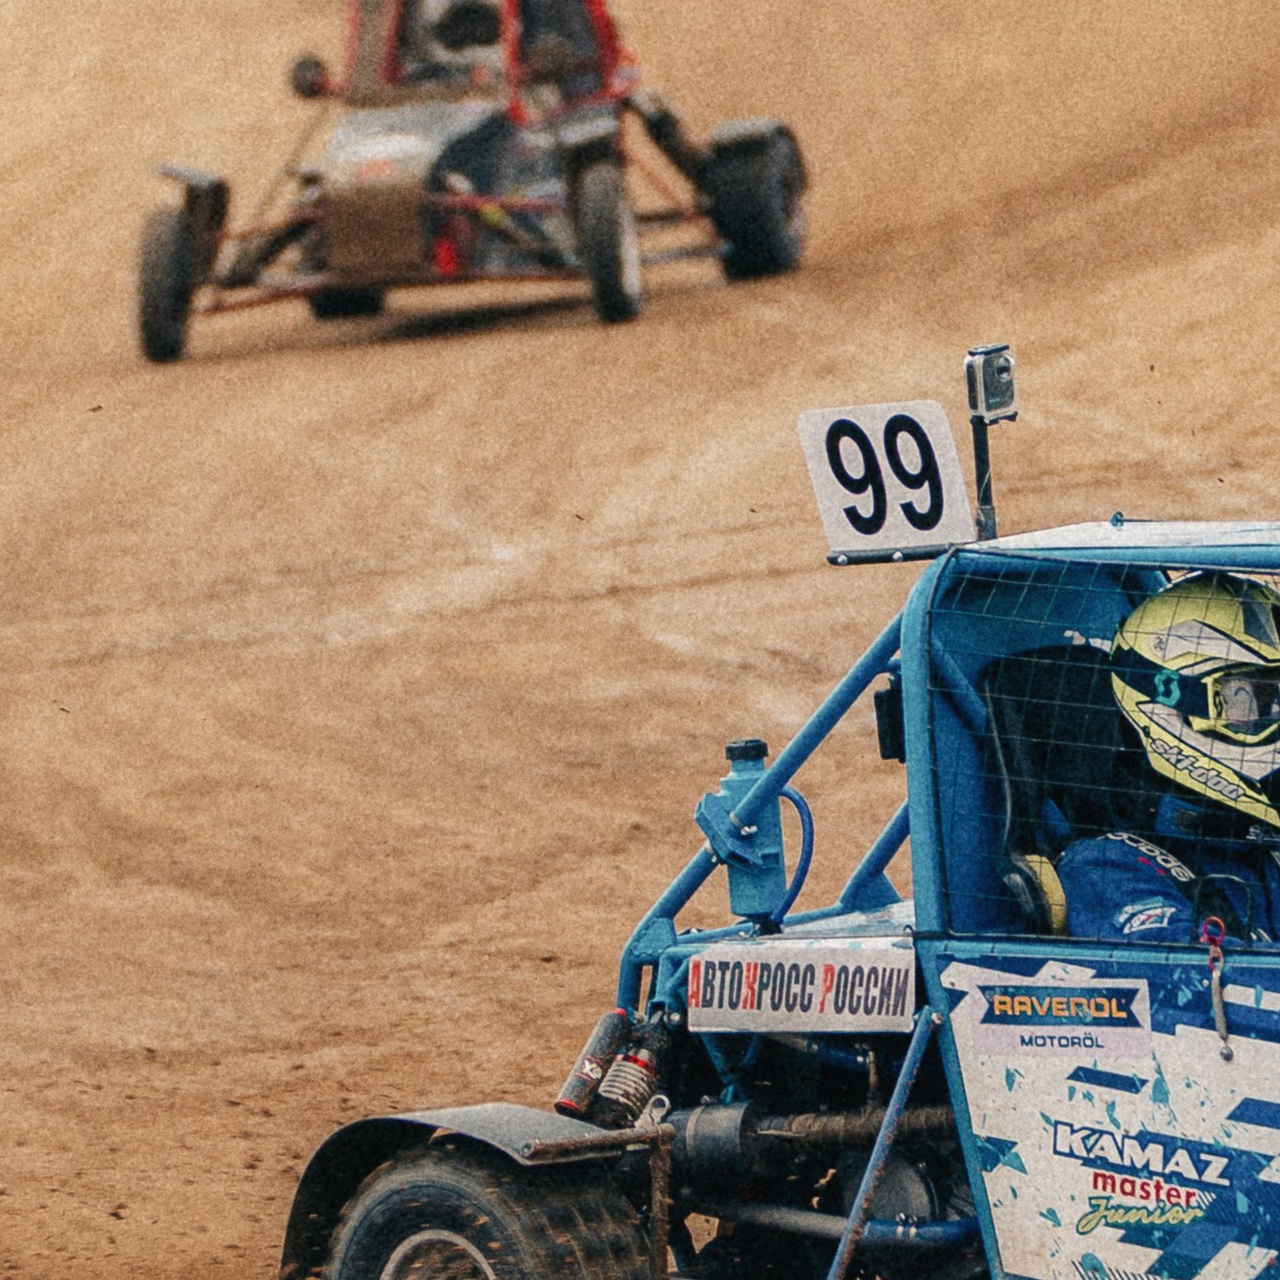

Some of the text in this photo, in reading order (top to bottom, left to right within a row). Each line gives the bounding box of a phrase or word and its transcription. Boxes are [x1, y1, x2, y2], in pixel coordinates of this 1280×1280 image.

[825, 413, 944, 536] 99
[688, 959, 910, 1017] АВТОКРОСС РОССИИ
[993, 995, 1128, 1019] RAVENOL
[1020, 1032, 1106, 1049] MOTORÖL
[1055, 1122, 1231, 1187] KAMAZ
[1093, 1171, 1197, 1207] master
[1076, 1196, 1206, 1236] Junior
